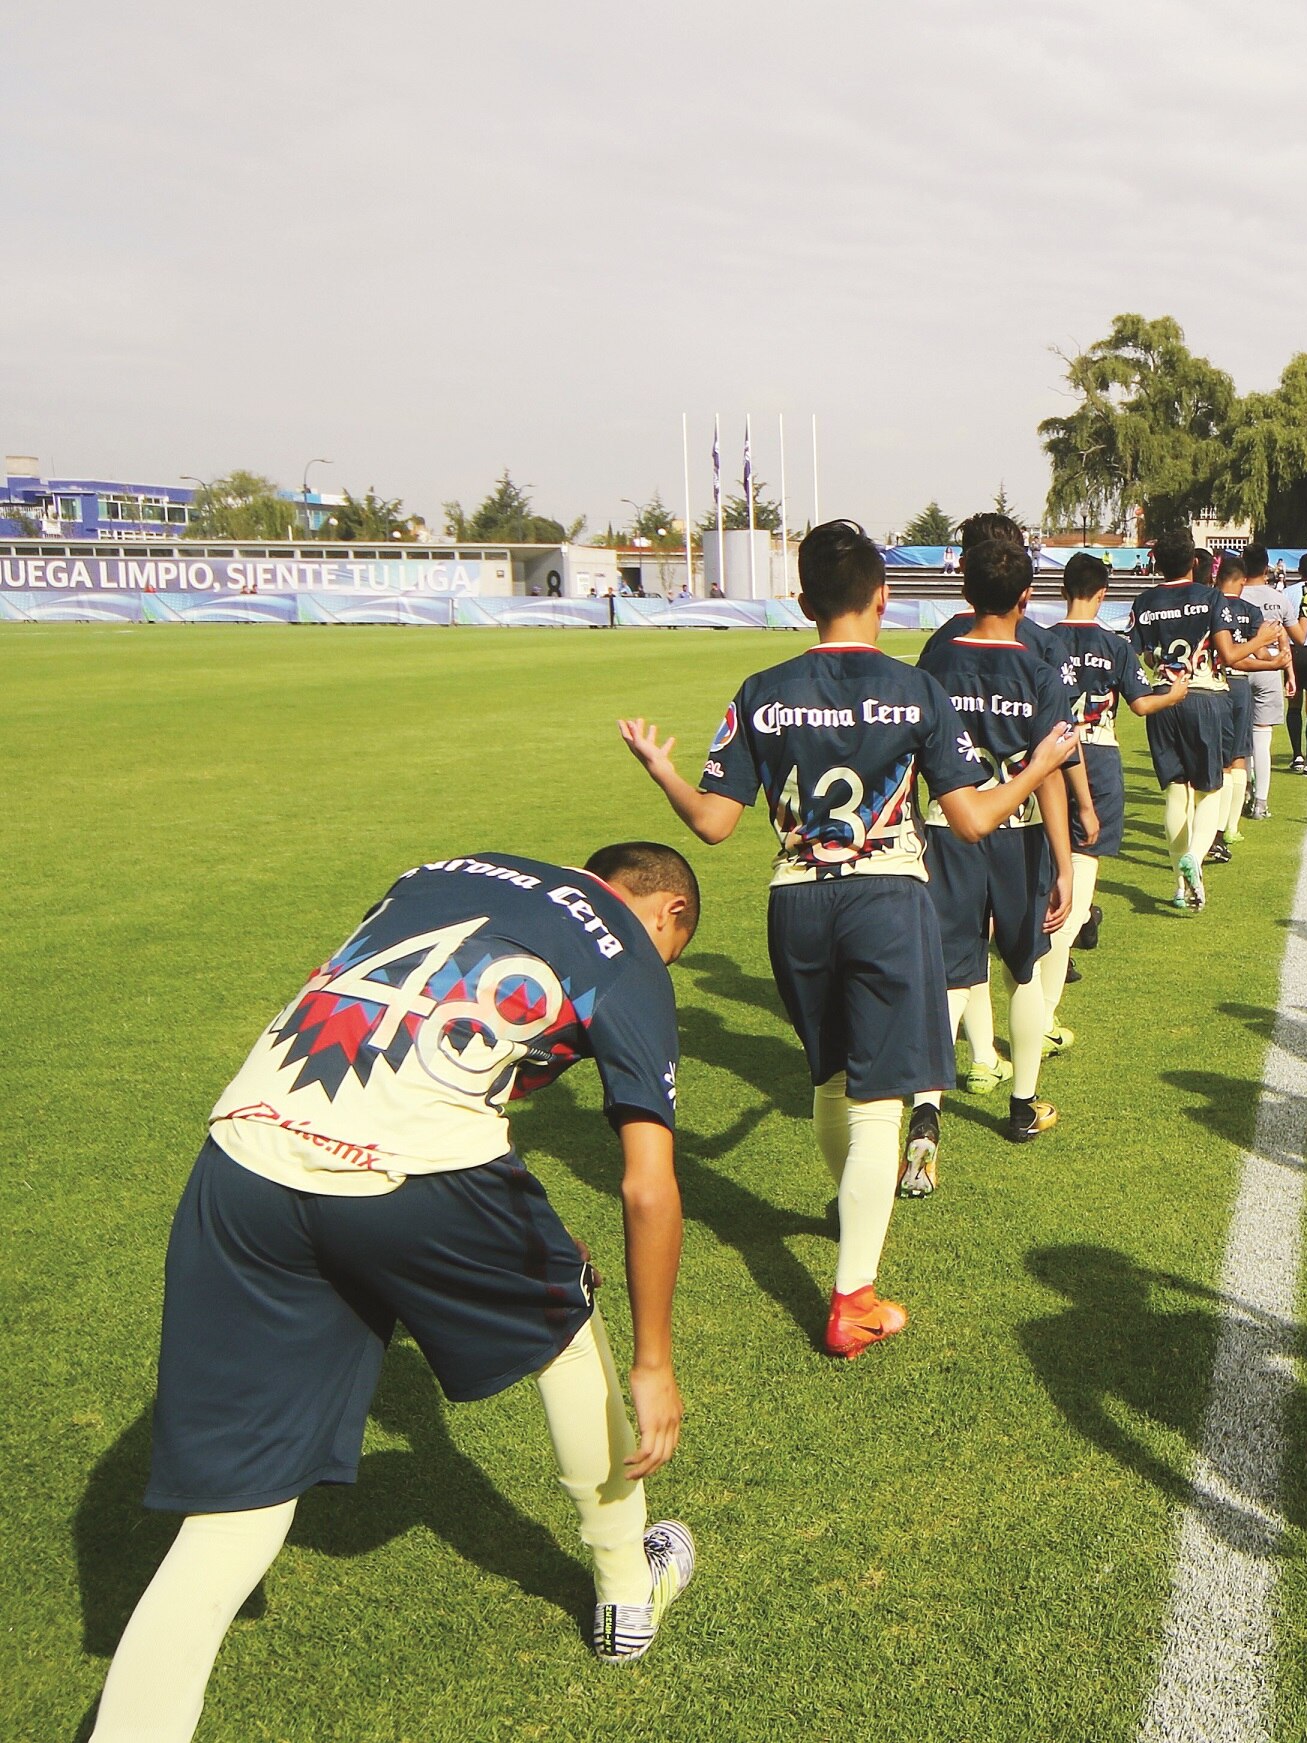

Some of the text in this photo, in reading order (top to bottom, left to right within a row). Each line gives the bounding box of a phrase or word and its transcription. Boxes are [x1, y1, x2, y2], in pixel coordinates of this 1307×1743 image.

[0, 560, 472, 593] UEGA LIMPIO, SIENTE TU LIGA
[1139, 603, 1210, 626] Corona Cero
[1084, 652, 1112, 670] Cero
[753, 698, 921, 736] Corona Cero
[990, 693, 1033, 718] Cero
[546, 885, 624, 960] Cero
